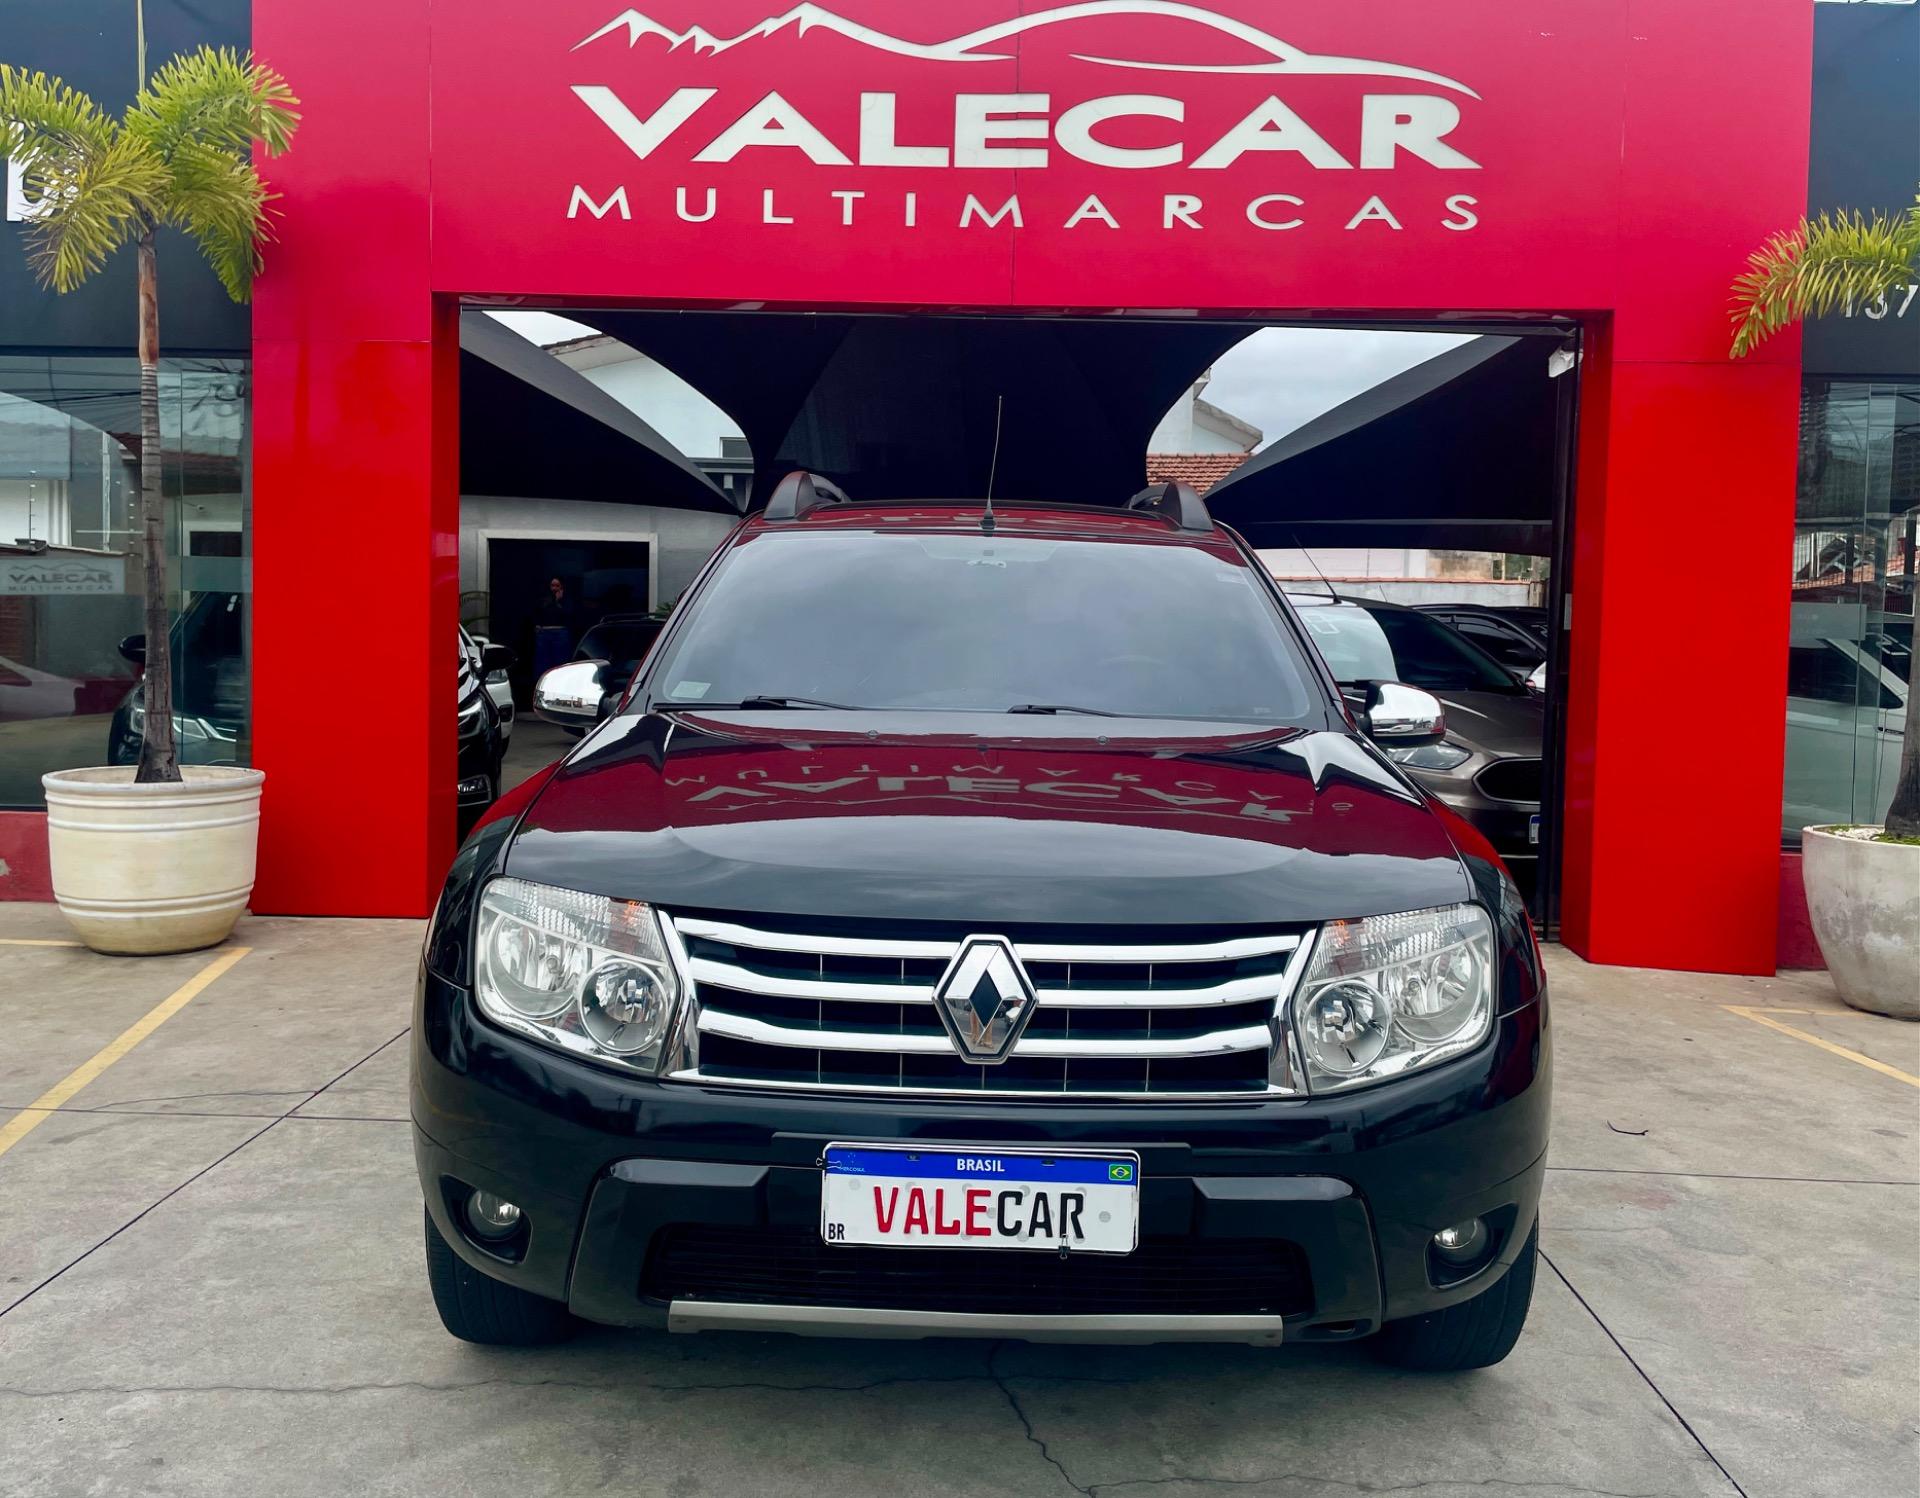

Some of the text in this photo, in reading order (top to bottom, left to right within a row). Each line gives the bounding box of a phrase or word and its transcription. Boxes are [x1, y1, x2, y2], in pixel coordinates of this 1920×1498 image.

[571, 85, 1482, 170] VALECAR
[566, 185, 1479, 232] MULTIMARCAS
[9, 573, 112, 583] VALECAR
[957, 1158, 1005, 1172] BRASIL
[873, 1186, 1085, 1239] VALECAR
[828, 1223, 845, 1240] BR
